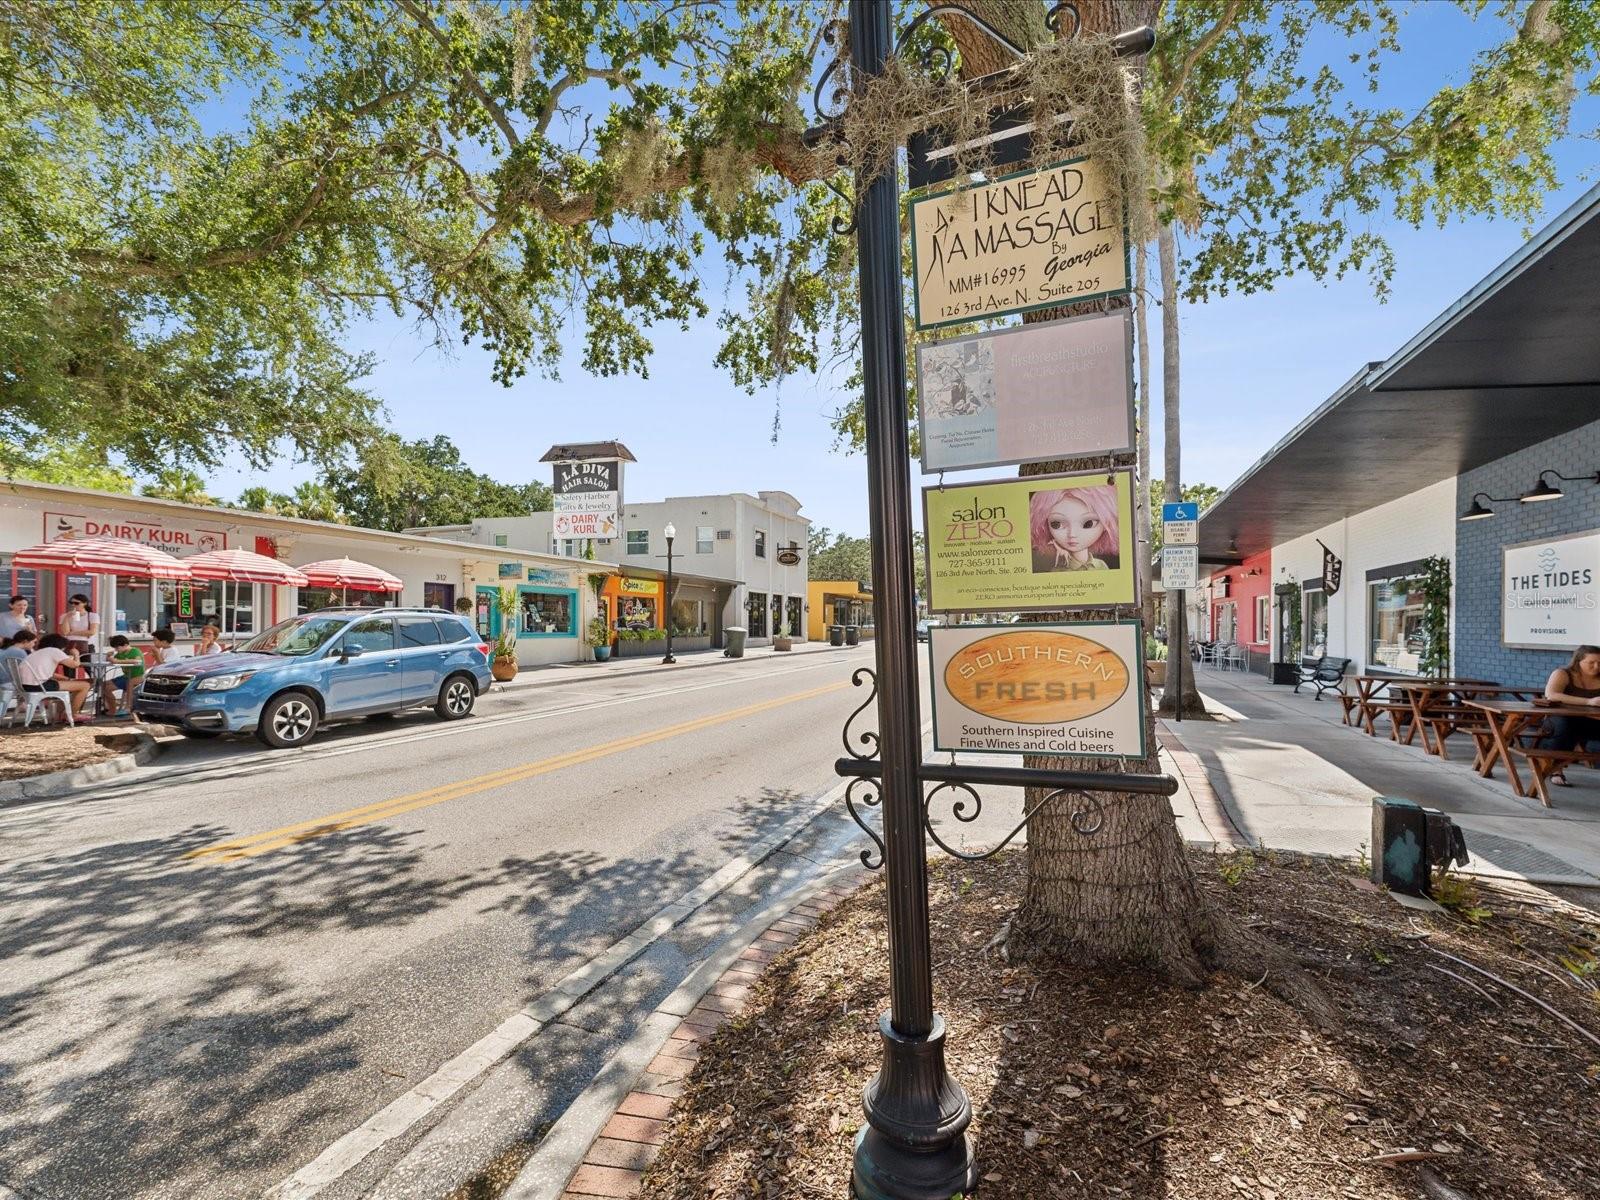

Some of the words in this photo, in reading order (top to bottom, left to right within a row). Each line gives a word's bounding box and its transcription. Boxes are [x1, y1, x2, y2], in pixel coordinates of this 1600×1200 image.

[973, 194, 978, 222] I
[985, 169, 1084, 219] KNEAD
[947, 233, 968, 264] A
[974, 200, 1117, 257] MASSAGE
[1051, 241, 1067, 255] By
[1044, 242, 1113, 281] Georgia
[949, 265, 1026, 295] MM#16995
[940, 306, 960, 317] 126
[963, 295, 982, 313] 3rd
[984, 293, 1013, 311] Ave.
[1015, 288, 1031, 306] N.
[1037, 282, 1074, 301] Suite
[1076, 277, 1100, 291] 205
[562, 464, 580, 481] LA
[582, 463, 610, 480] DIVA
[562, 478, 582, 493] HAIR
[583, 477, 610, 491] SALON
[562, 494, 583, 502] Safety
[584, 493, 610, 501] Harbor
[585, 502, 612, 511] Jewelry
[952, 497, 1006, 522] salon
[571, 514, 599, 524] DAIRY
[85, 522, 144, 541] DAIRY
[149, 530, 194, 545] KURL
[573, 525, 598, 534] KURL
[945, 520, 1014, 541] ZERO
[937, 547, 1024, 559] www.salonzero.com
[948, 557, 1006, 568] 727-365-9111
[948, 569, 960, 577] 3rd
[961, 568, 975, 577] Ave
[1511, 574, 1540, 591] THE
[1544, 569, 1592, 588] TIDES
[181, 581, 192, 615] OPEN
[1530, 627, 1567, 635] PROVISIONS
[959, 645, 1115, 682] SOUTHERN
[975, 681, 1097, 701] FRESH
[962, 724, 1014, 736] Southern
[1017, 725, 1065, 739] Inspired
[1068, 726, 1114, 739] Cuisine
[960, 737, 983, 748] Fine
[985, 738, 1020, 749] Wines
[1023, 738, 1046, 750] and
[1048, 739, 1077, 751] Cold
[1079, 740, 1115, 752] beers
